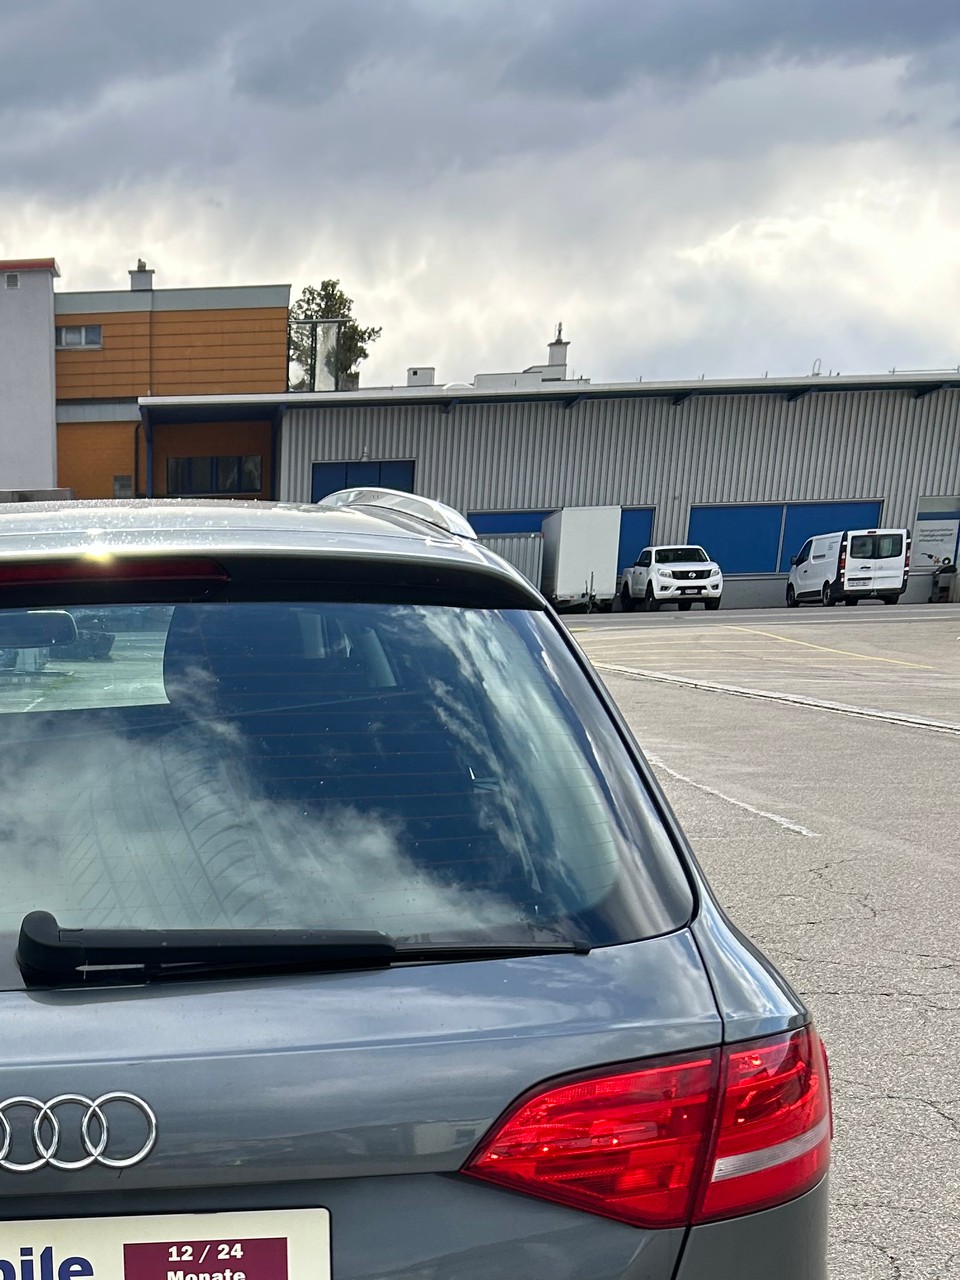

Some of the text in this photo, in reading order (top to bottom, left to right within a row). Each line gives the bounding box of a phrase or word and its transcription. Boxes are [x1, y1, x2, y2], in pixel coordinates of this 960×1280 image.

[167, 1243, 244, 1264] 12 / 24
